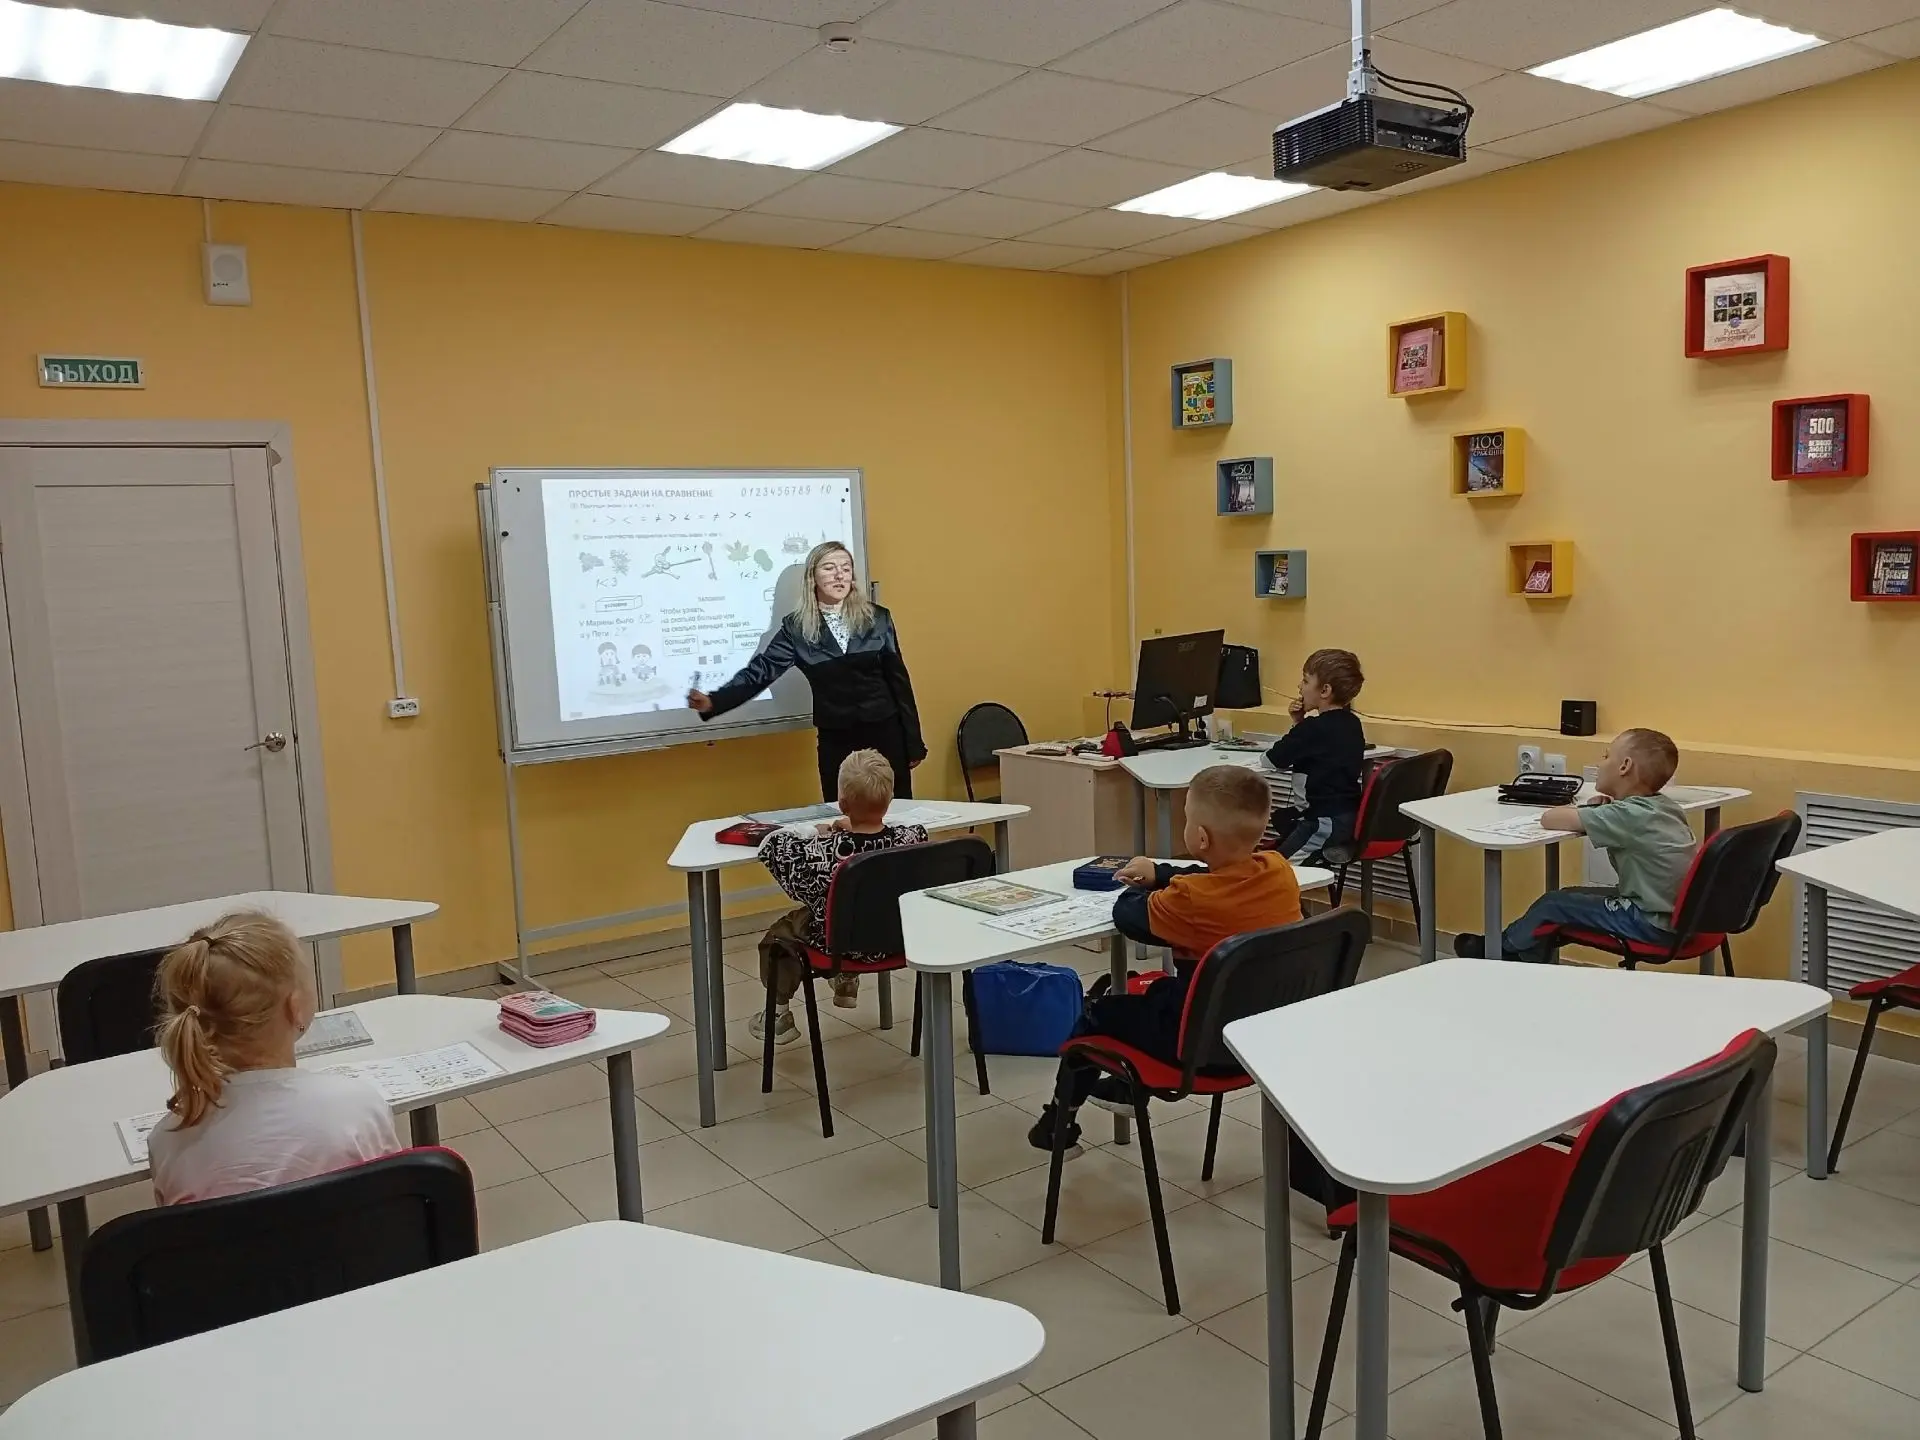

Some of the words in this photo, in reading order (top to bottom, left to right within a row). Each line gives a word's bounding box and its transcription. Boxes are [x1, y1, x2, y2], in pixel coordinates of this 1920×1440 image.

[48, 364, 135, 383] ВЫХОД
[1809, 417, 1835, 435] 500
[568, 489, 611, 498] ПРОСТЫЕ
[614, 489, 650, 499] ЗАДАЧИ
[652, 489, 664, 498] НА
[665, 489, 714, 498] СРАВНЕНИЕ
